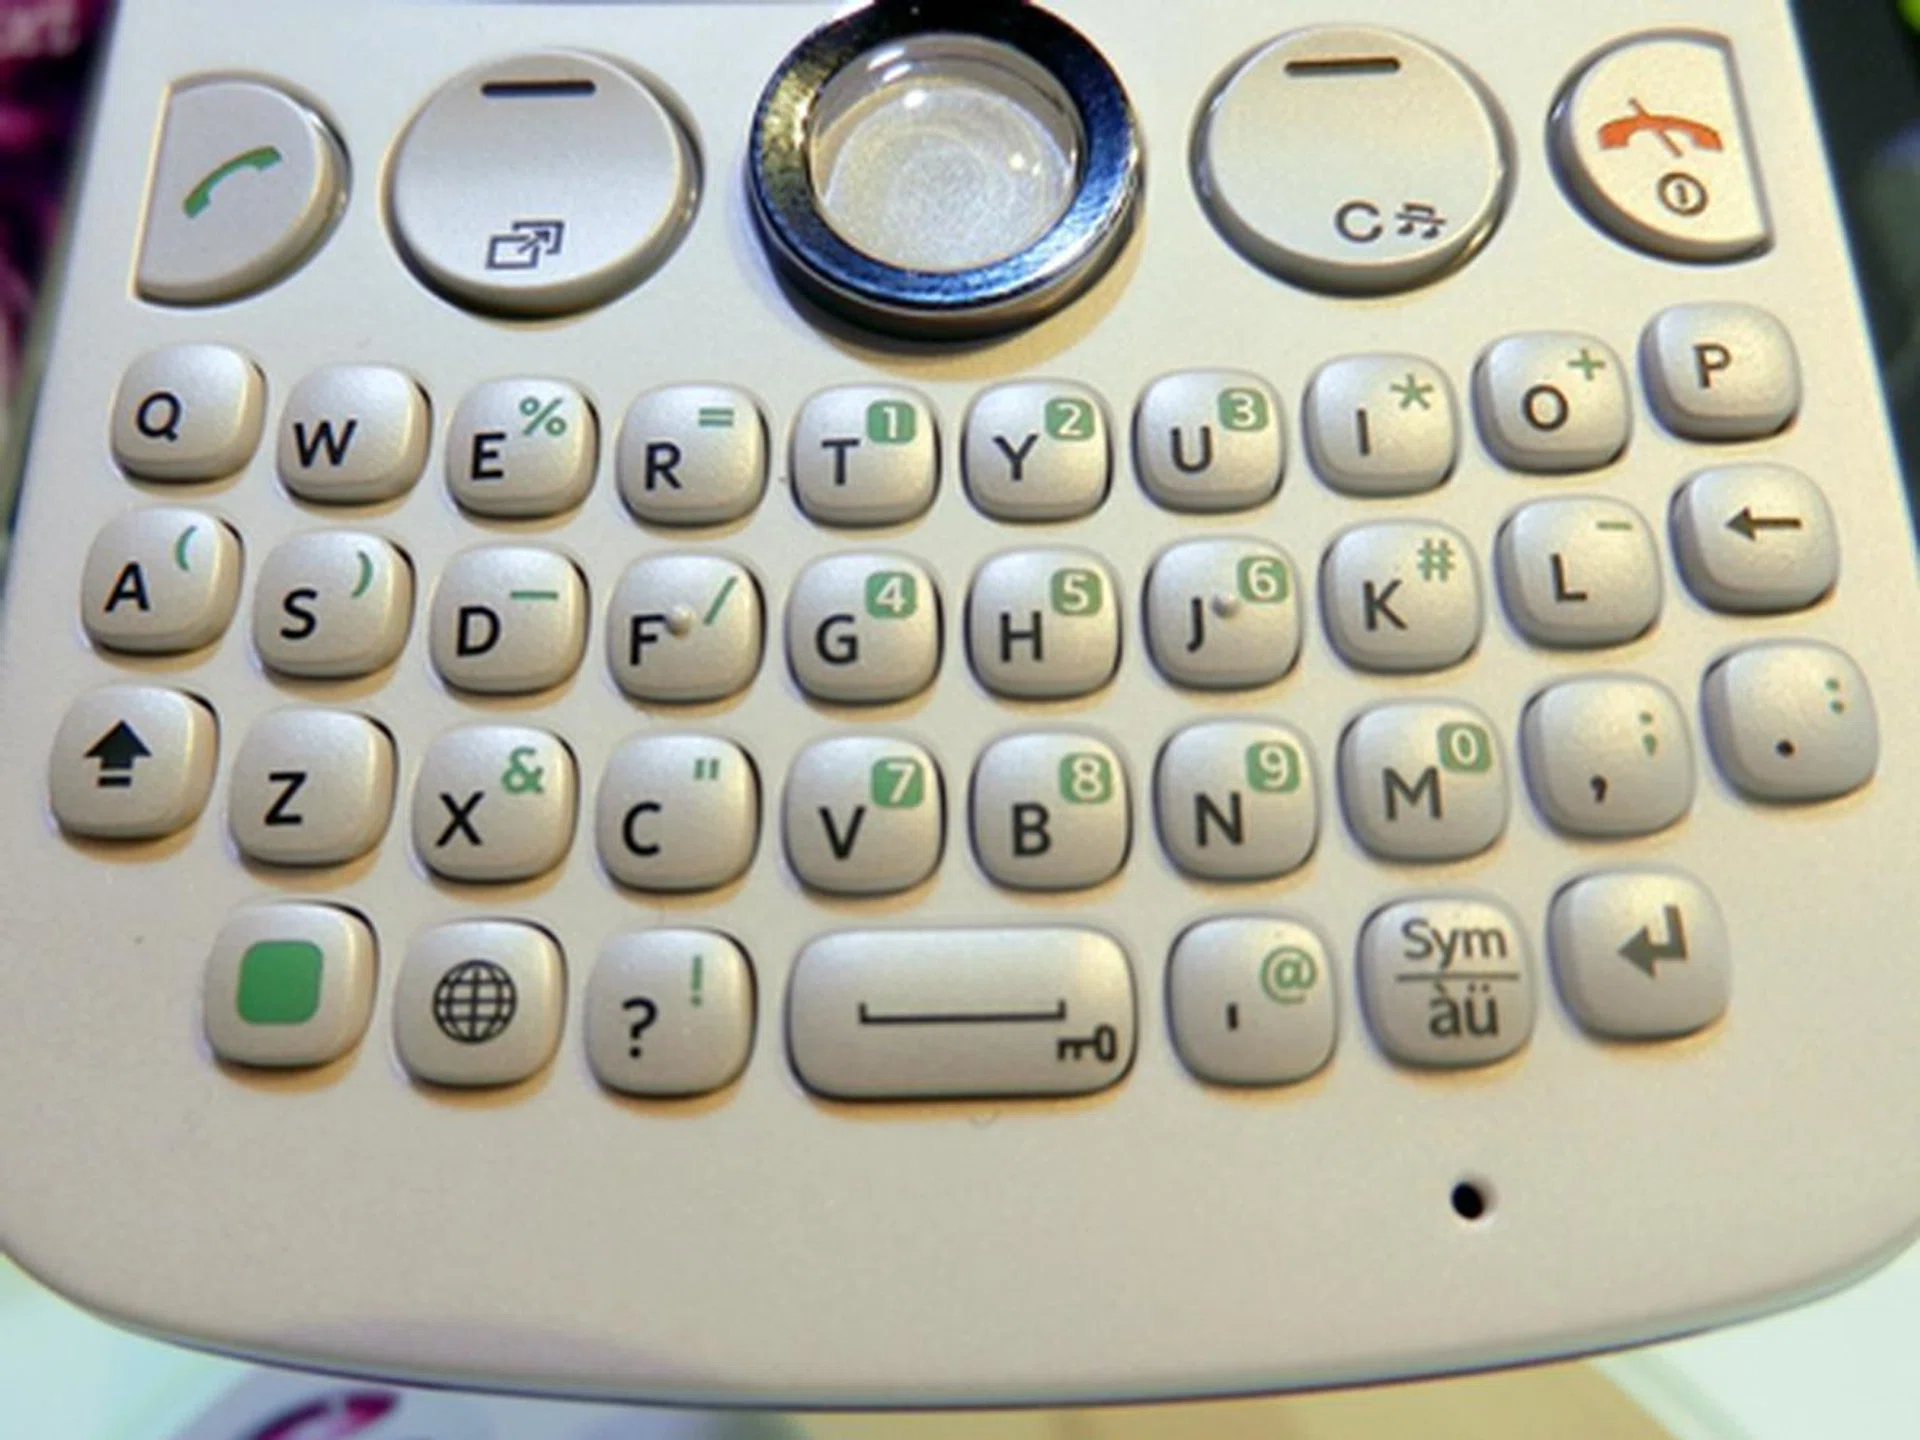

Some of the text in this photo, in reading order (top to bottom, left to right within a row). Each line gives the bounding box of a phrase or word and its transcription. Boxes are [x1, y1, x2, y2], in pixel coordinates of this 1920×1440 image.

[1335, 202, 1383, 243] C
[1568, 349, 1605, 380] +
[1694, 344, 1731, 389] P
[136, 392, 180, 441] Q
[520, 398, 566, 436] %
[699, 409, 733, 427] =
[1059, 404, 1082, 436] 2
[1231, 392, 1256, 427] 3
[1522, 385, 1568, 432] O
[294, 420, 356, 468] W
[471, 433, 505, 480] E
[1171, 427, 1212, 474] U
[1357, 410, 1371, 457] I
[645, 443, 681, 491] R
[822, 439, 859, 486] T
[994, 435, 1038, 482] Y
[176, 527, 195, 571] (
[1418, 539, 1453, 581] #
[104, 563, 149, 612] A
[352, 552, 372, 598] )
[877, 576, 905, 612] 4
[1064, 574, 1088, 610] 5
[1249, 560, 1277, 598] 6
[1551, 554, 1588, 603] L
[281, 589, 316, 640] S
[702, 578, 736, 626] /
[1187, 598, 1204, 653] J
[1364, 580, 1407, 632] K
[457, 607, 500, 657] D
[630, 615, 667, 666] F
[815, 615, 858, 665] G
[1000, 612, 1043, 663] H
[1826, 680, 1844, 715] :
[1260, 746, 1289, 784] 9
[1451, 728, 1477, 763] 0
[501, 748, 543, 794] &
[888, 760, 918, 802] 7
[1073, 760, 1102, 799] 8
[1384, 767, 1442, 822] M
[1591, 776, 1607, 802] ,
[265, 772, 306, 826] Z
[436, 792, 483, 847] X
[1195, 793, 1243, 848] N
[623, 802, 660, 857] C
[820, 807, 865, 860] V
[1013, 804, 1051, 857] B
[1402, 919, 1507, 967] Sym
[1260, 949, 1315, 1005] @
[623, 998, 657, 1058] ?
[1429, 982, 1498, 1038] àü
